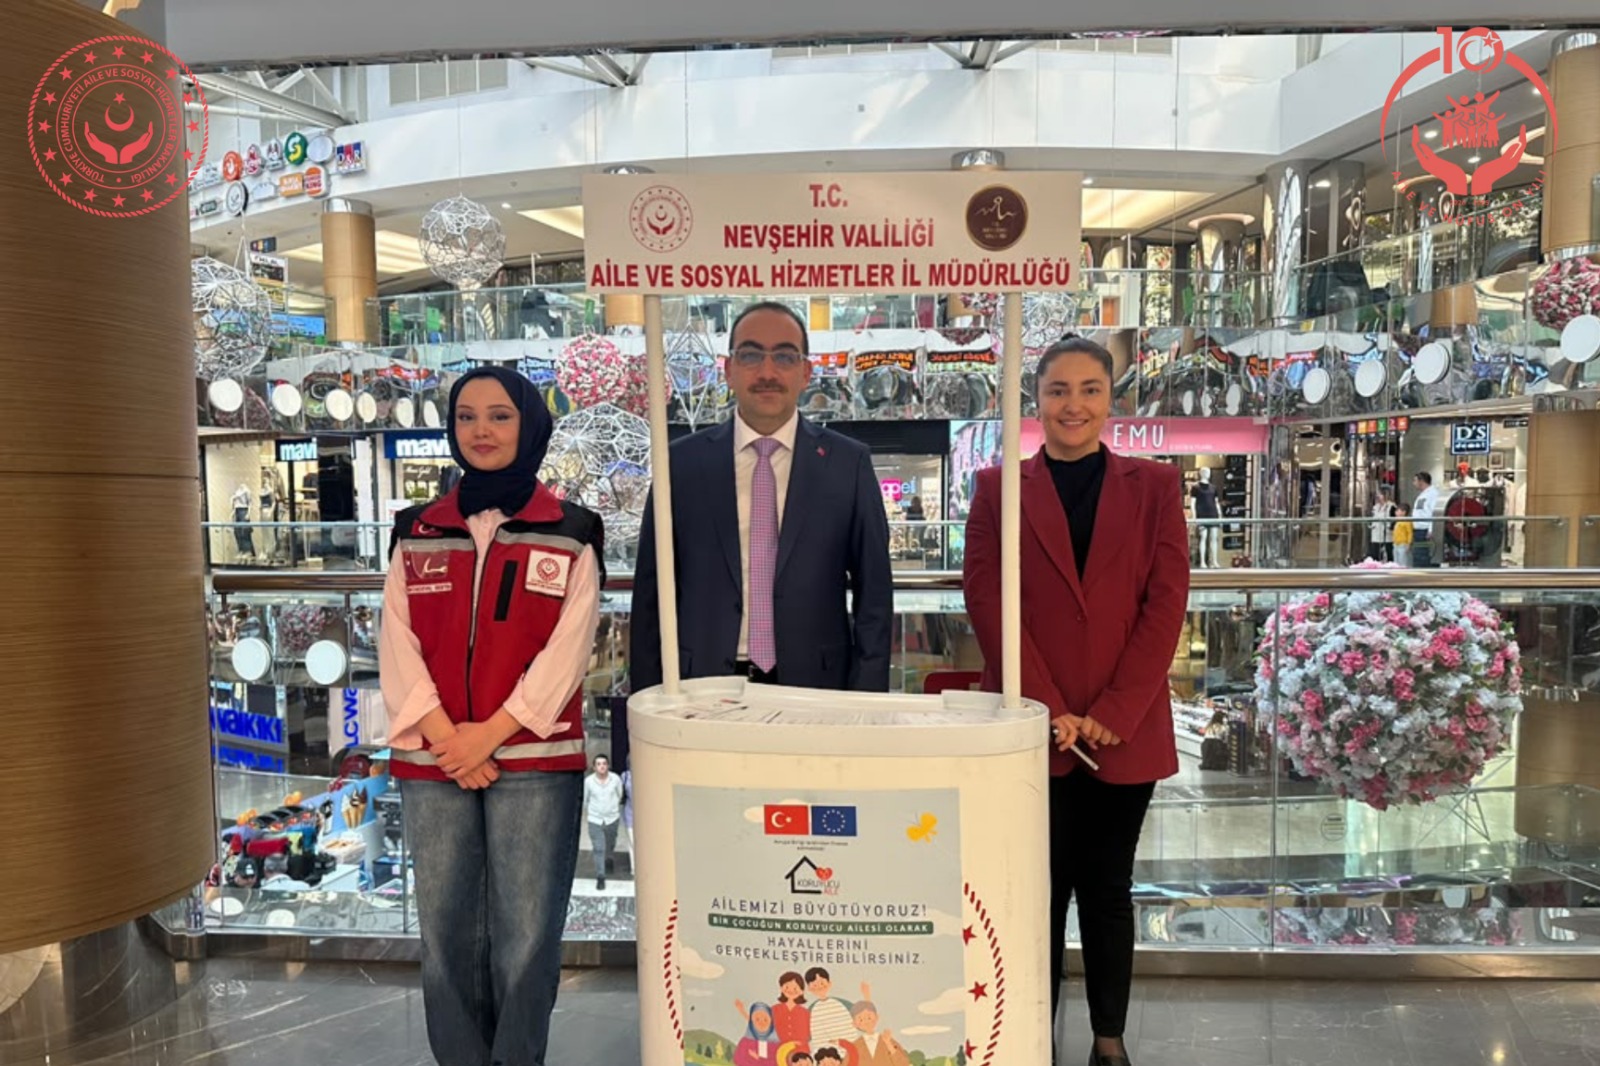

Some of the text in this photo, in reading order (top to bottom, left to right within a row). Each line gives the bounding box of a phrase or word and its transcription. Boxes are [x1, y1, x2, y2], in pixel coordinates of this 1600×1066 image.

[809, 183, 848, 208] T.C.
[724, 218, 934, 254] NEVŞEHİR VALİLİĞİ
[591, 257, 1070, 288] AİLE VE SOSYAL HİZMETLER İL MÜDÜRLÜĞÜ
[1113, 424, 1164, 448] EMU
[1456, 424, 1486, 440] D'S
[280, 437, 317, 460] mavi
[396, 433, 450, 457] mavi
[711, 896, 926, 917] AİLEMİZİ BÜYÜTÜYORUZ!
[712, 916, 928, 932] BİR ÇOCUĞUN KORUYUCU AİLESİ OLARAK
[715, 944, 925, 965] GERÇEKLEŞTİREBİLİRSİNİZ.
[767, 936, 868, 950] HAYALLERİNİ
